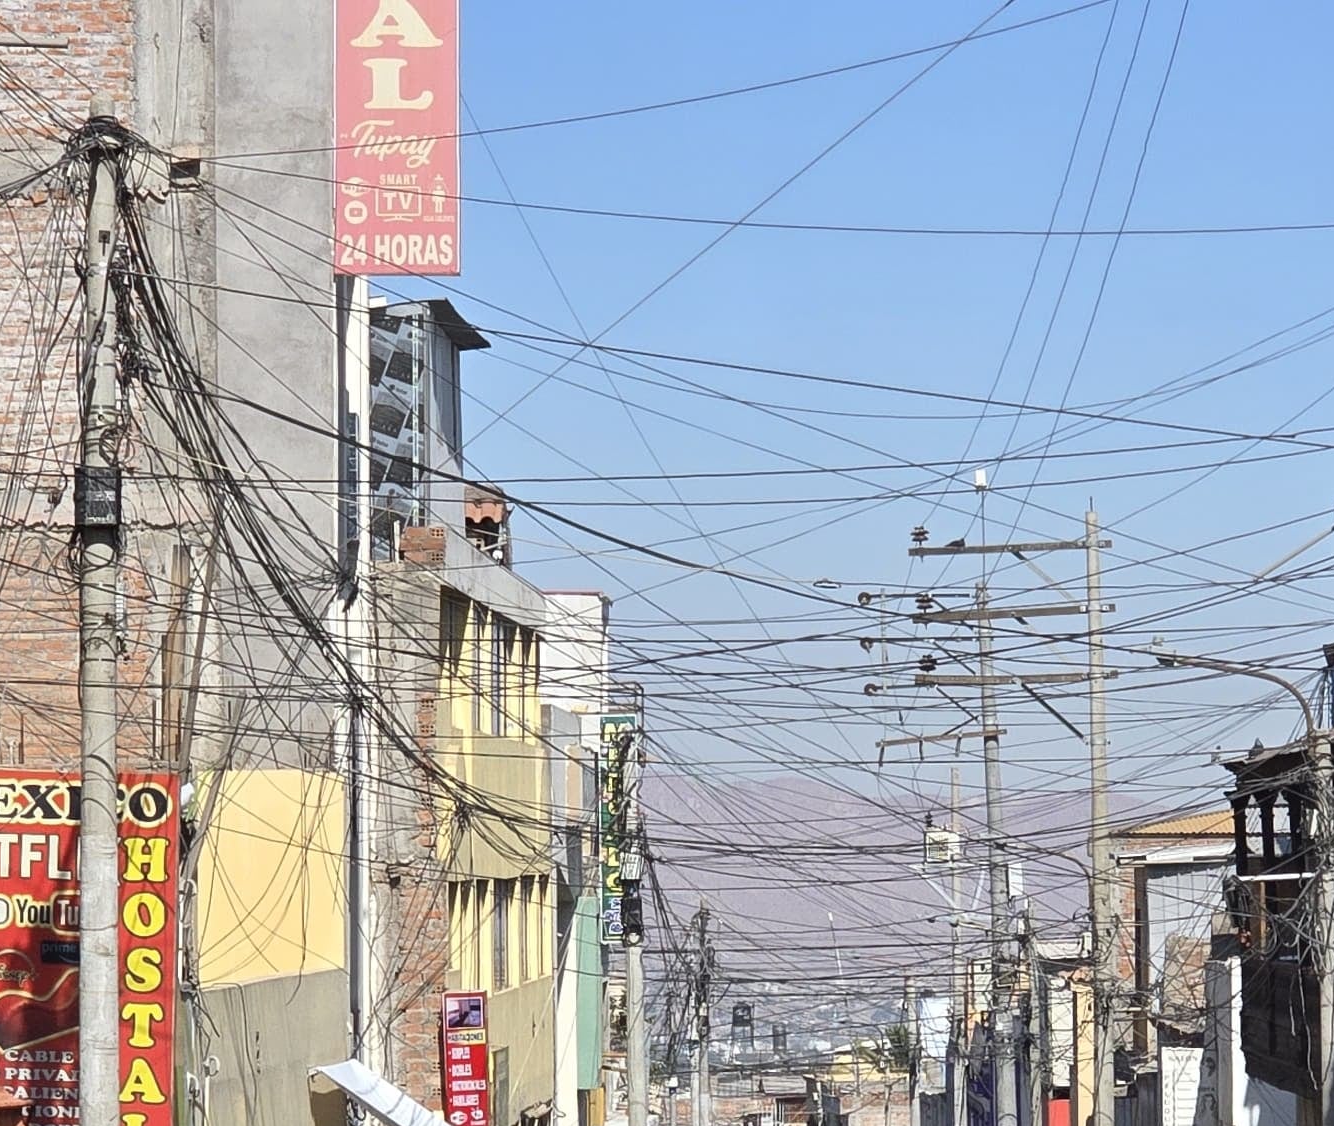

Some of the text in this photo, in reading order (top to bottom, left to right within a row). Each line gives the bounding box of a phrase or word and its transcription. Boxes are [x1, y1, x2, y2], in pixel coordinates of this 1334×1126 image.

[379, 174, 418, 186] SMART
[383, 192, 413, 210] TV
[340, 234, 454, 266] 24 HORAS
[5, 1050, 75, 1064] CABLE
